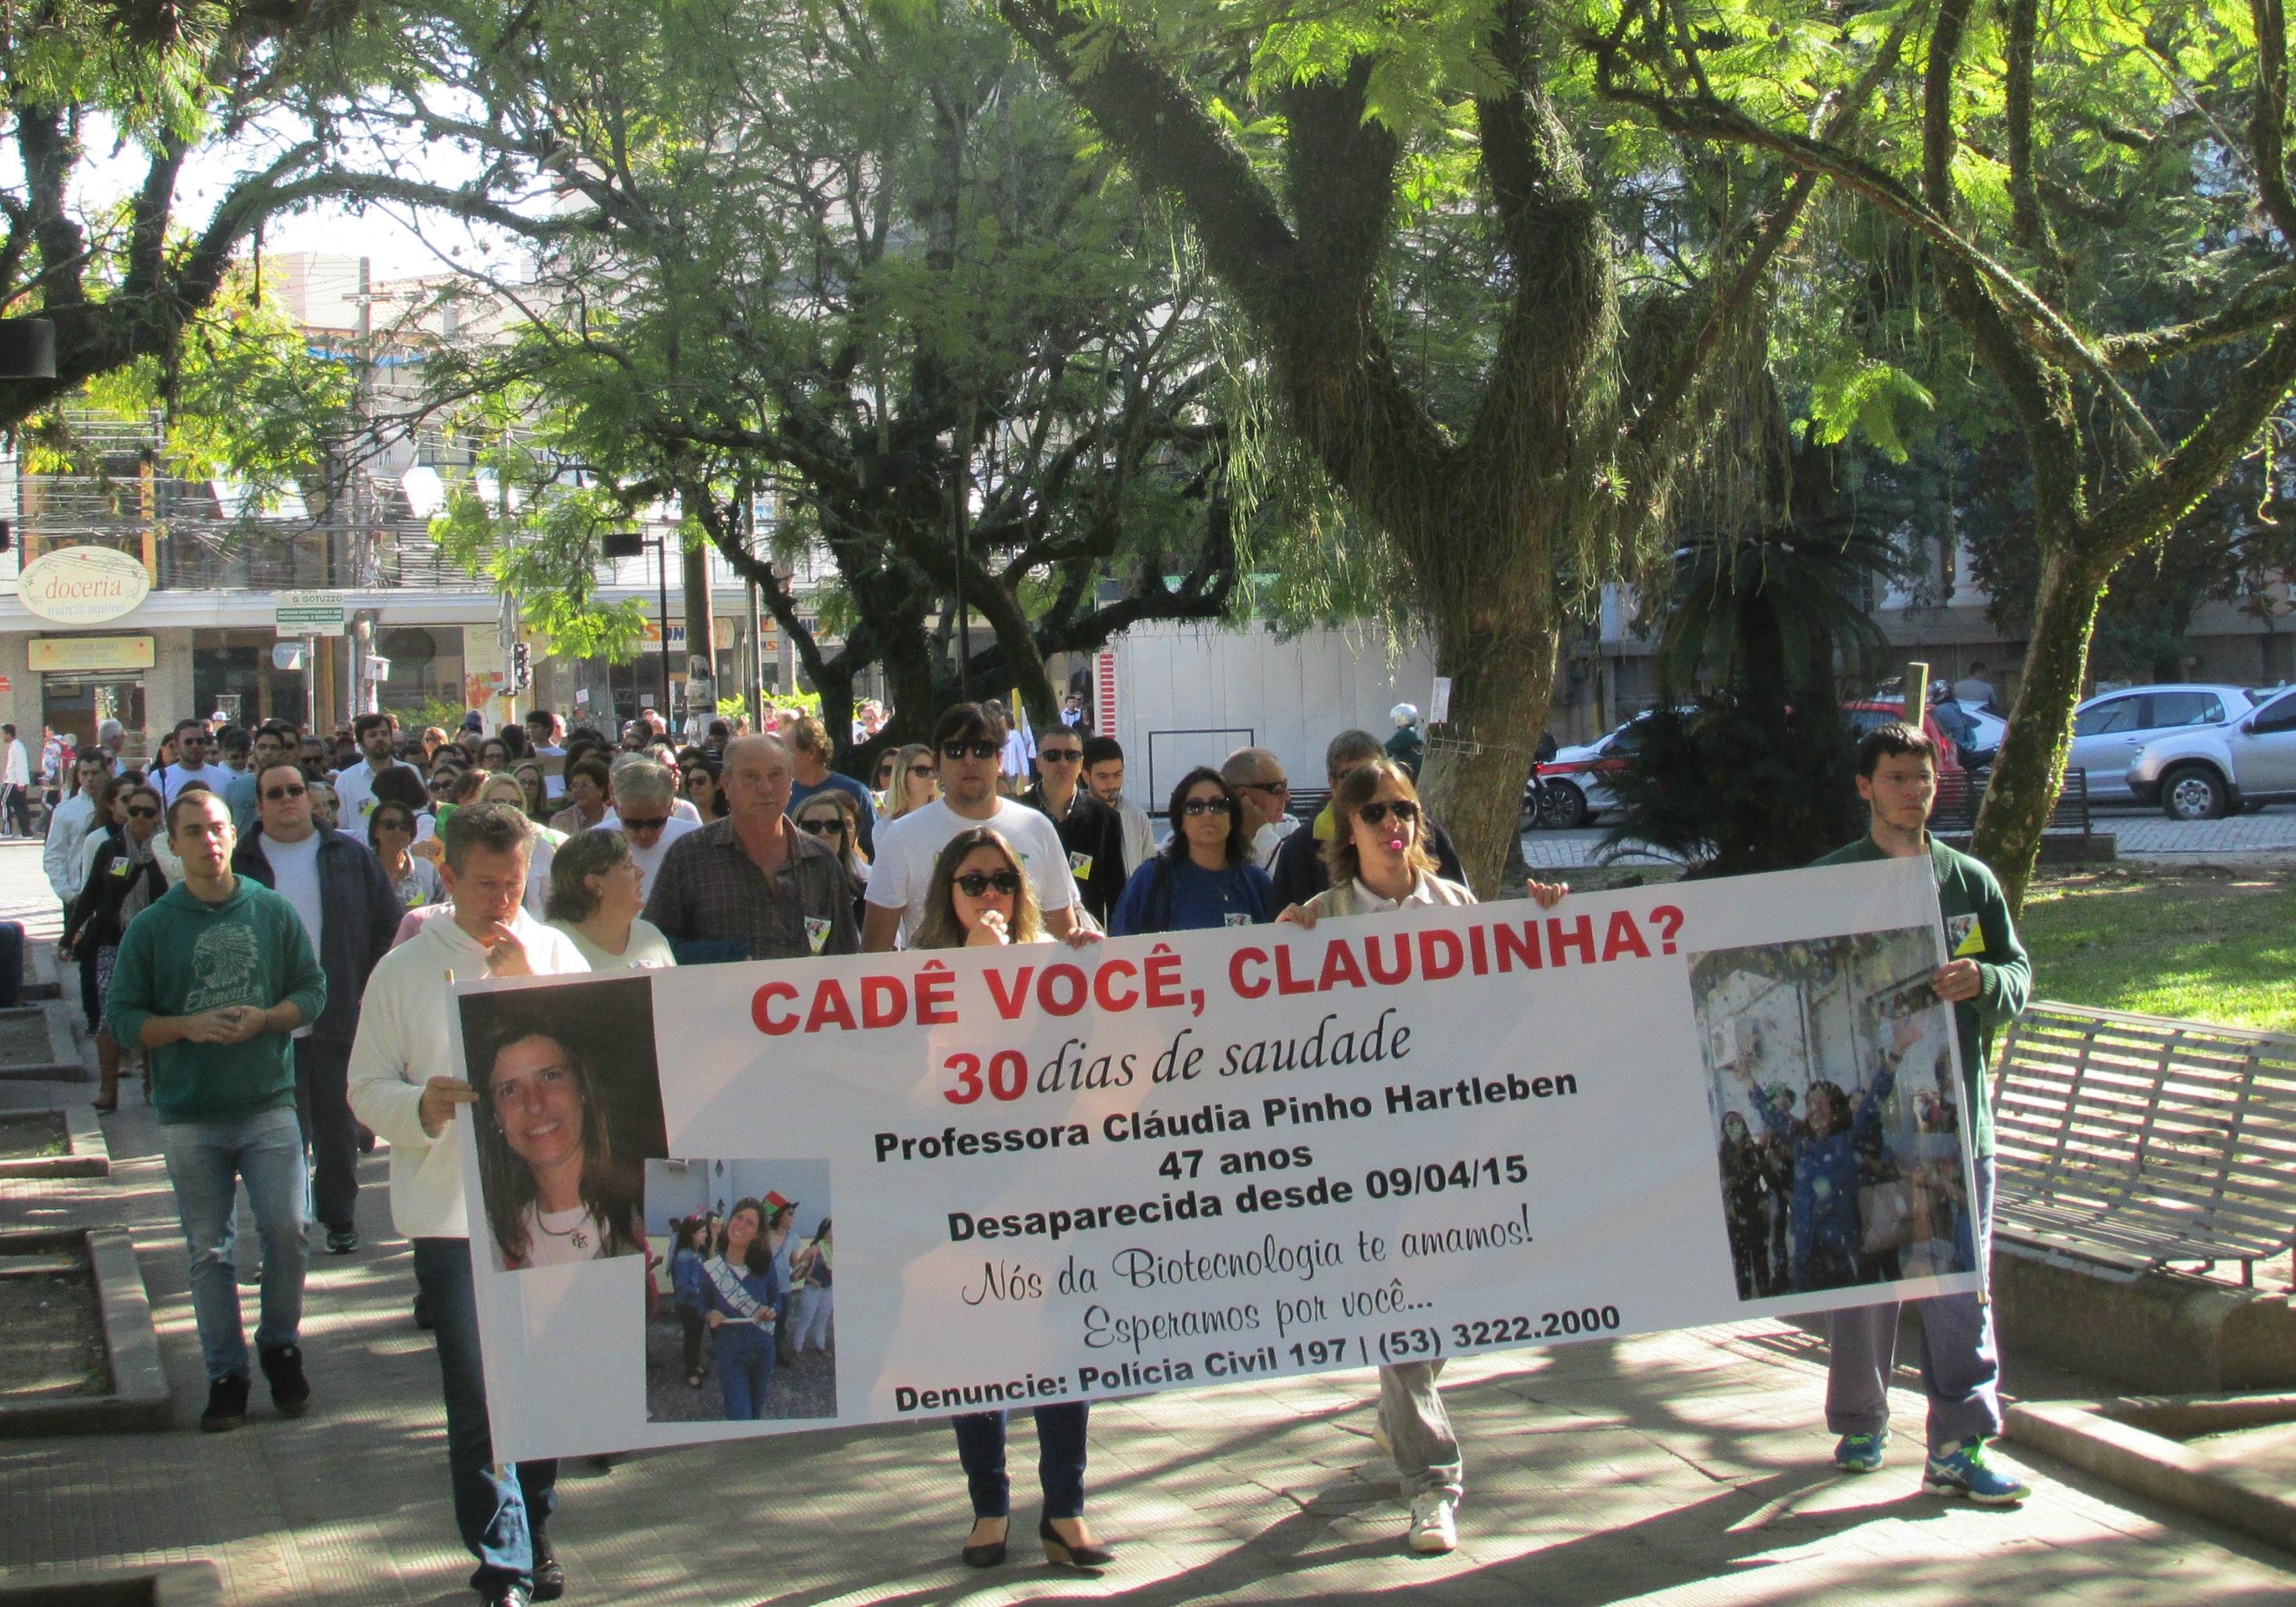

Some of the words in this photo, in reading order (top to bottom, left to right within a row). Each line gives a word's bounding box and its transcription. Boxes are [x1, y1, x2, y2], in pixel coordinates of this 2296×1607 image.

[45, 576, 122, 599] doceria
[751, 959, 959, 1036] CADÊ
[983, 942, 1205, 1020] VOCÊ,
[1229, 905, 1684, 999] CLAUDINHA?
[942, 1049, 1029, 1105] 30
[1036, 1038, 1137, 1093] dias
[1152, 1028, 1204, 1084] de
[1218, 1007, 1411, 1077] saudade
[874, 1124, 1089, 1163] Professora
[1103, 1103, 1250, 1142] Cláudia
[1262, 1092, 1372, 1128] Pinho
[1384, 1073, 1578, 1114] Hartleben
[1158, 1149, 1204, 1180] 47
[1219, 1145, 1313, 1175] anos
[947, 1190, 1222, 1242] Desaparecida
[1235, 1176, 1353, 1214] desde
[1365, 1154, 1528, 1200] 09/04/15
[961, 1258, 1042, 1306] Nós
[1058, 1254, 1098, 1295] da
[1112, 1233, 1344, 1289] Biotecnologia
[1358, 1230, 1387, 1262] te
[1401, 1203, 1534, 1258] amamos!
[895, 1373, 1069, 1412] Denuncie:
[1078, 1358, 1194, 1392] Polícia
[1204, 1346, 1278, 1377] Civil
[1289, 1338, 1347, 1367] 197
[1379, 1327, 1443, 1363] (53)
[1453, 1305, 1621, 1348] 3222.2000
[1083, 1304, 1261, 1355] Esperamos
[1275, 1295, 1328, 1339] por
[1341, 1277, 1433, 1318] você...
